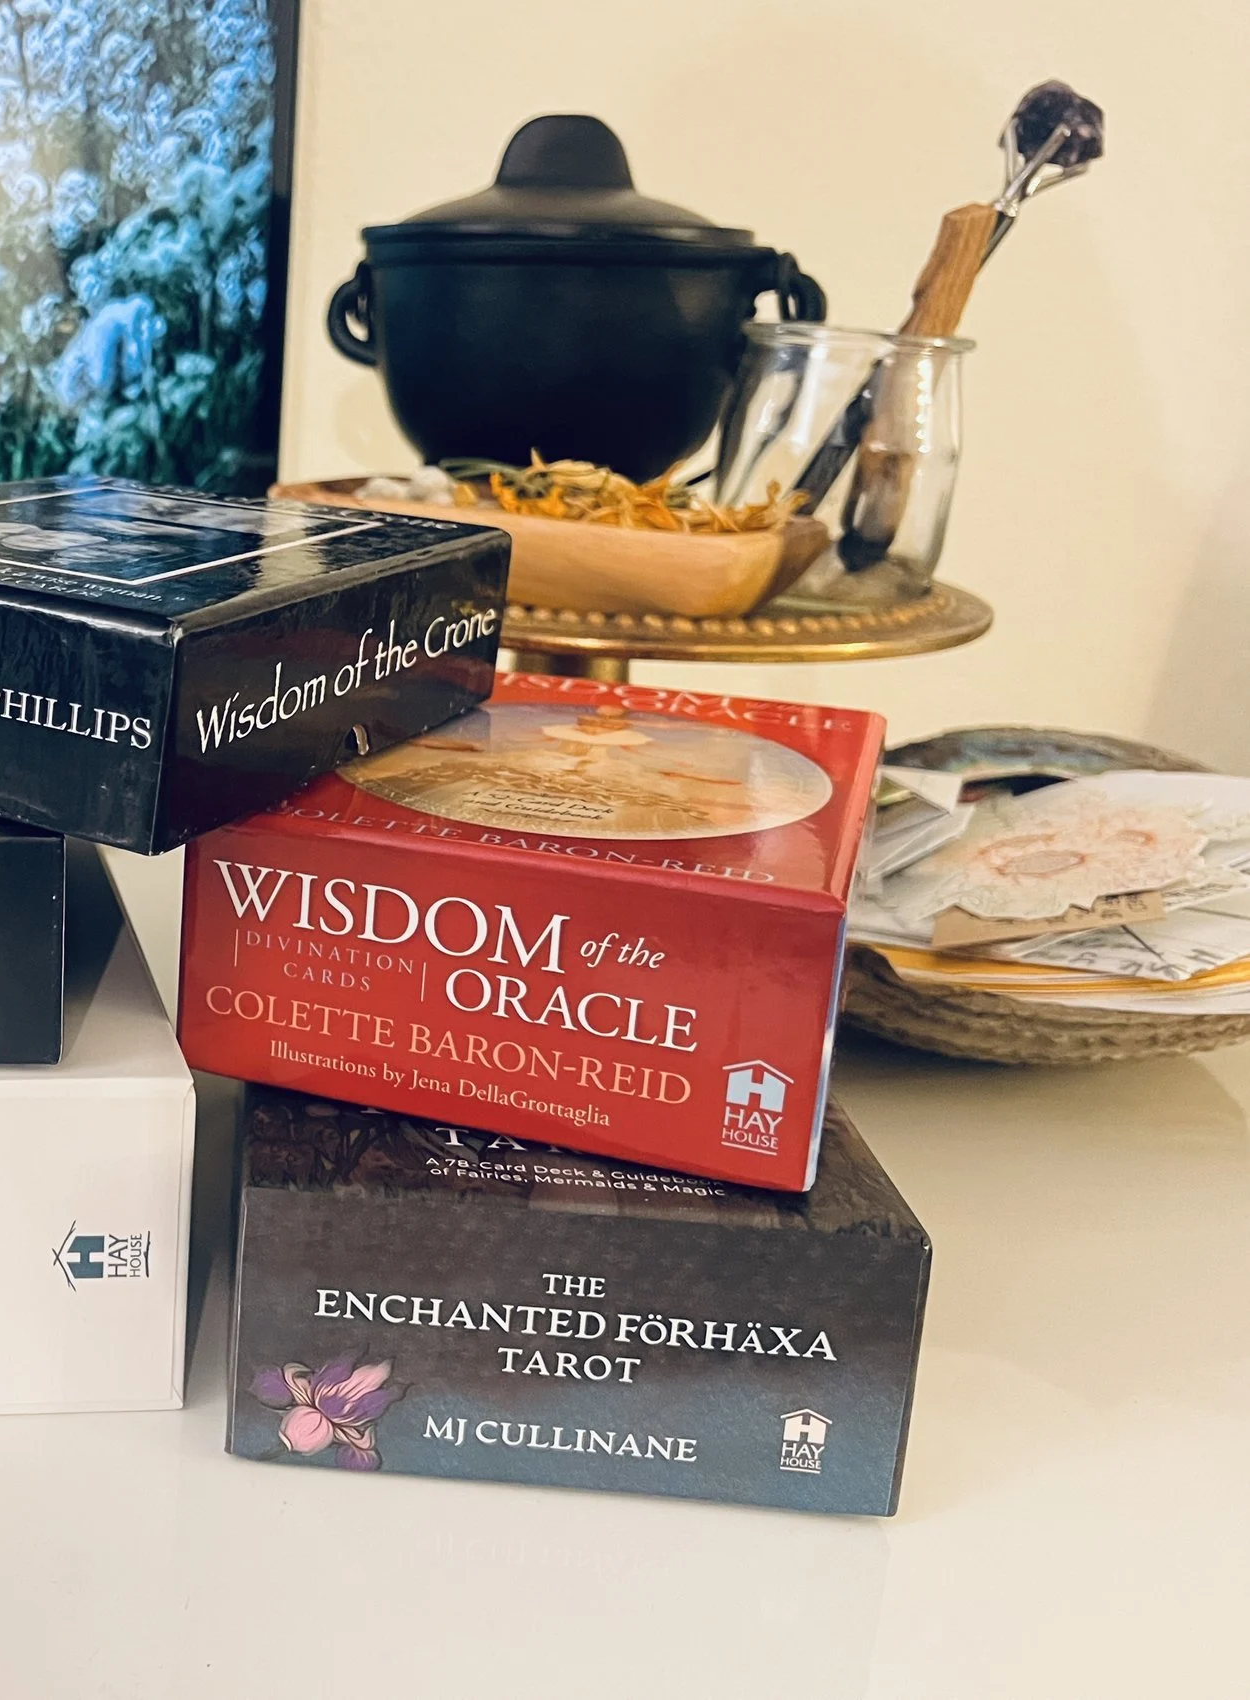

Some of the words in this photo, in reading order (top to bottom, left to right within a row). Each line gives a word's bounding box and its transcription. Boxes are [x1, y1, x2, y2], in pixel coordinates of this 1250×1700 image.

[196, 662, 327, 753] Wisdom
[334, 628, 373, 697] of
[374, 619, 418, 681] the
[424, 607, 496, 659] Crone
[479, 832, 774, 884] BARON-REID
[213, 859, 571, 974] WISDOM
[580, 933, 619, 968] of
[620, 937, 665, 969] the
[246, 930, 414, 975] DIVINATION
[283, 962, 371, 993] CARDS
[445, 968, 698, 1053] ORACLE
[205, 985, 396, 1049] COLETTE
[408, 1023, 691, 1105] BARON-REID
[270, 1039, 377, 1078] Illustrations
[382, 1062, 406, 1087] by
[409, 1068, 451, 1094] Jena
[458, 1079, 610, 1127] DellaGrottaglia
[722, 1127, 778, 1150] HOUSE
[723, 1105, 784, 1136] HAY
[426, 1157, 439, 1166] A
[445, 1158, 526, 1173] 78-Card
[533, 1165, 585, 1177] Deck
[592, 1170, 605, 1178] &
[430, 1167, 450, 1176] of
[456, 1168, 528, 1184] Fairies,
[535, 1175, 637, 1190] Mermaids
[643, 1183, 657, 1192] &
[662, 1184, 726, 1197] Magic
[107, 1233, 129, 1278] HAY
[129, 1233, 142, 1278] HOUSE
[542, 1273, 606, 1298] THE
[314, 1288, 607, 1340] ENCHANTED
[497, 1347, 641, 1384] TAROT
[423, 1415, 468, 1446] MJ
[475, 1420, 697, 1463] CULLINANE
[781, 1442, 825, 1460] HAY
[780, 1456, 822, 1470] HOUSE
